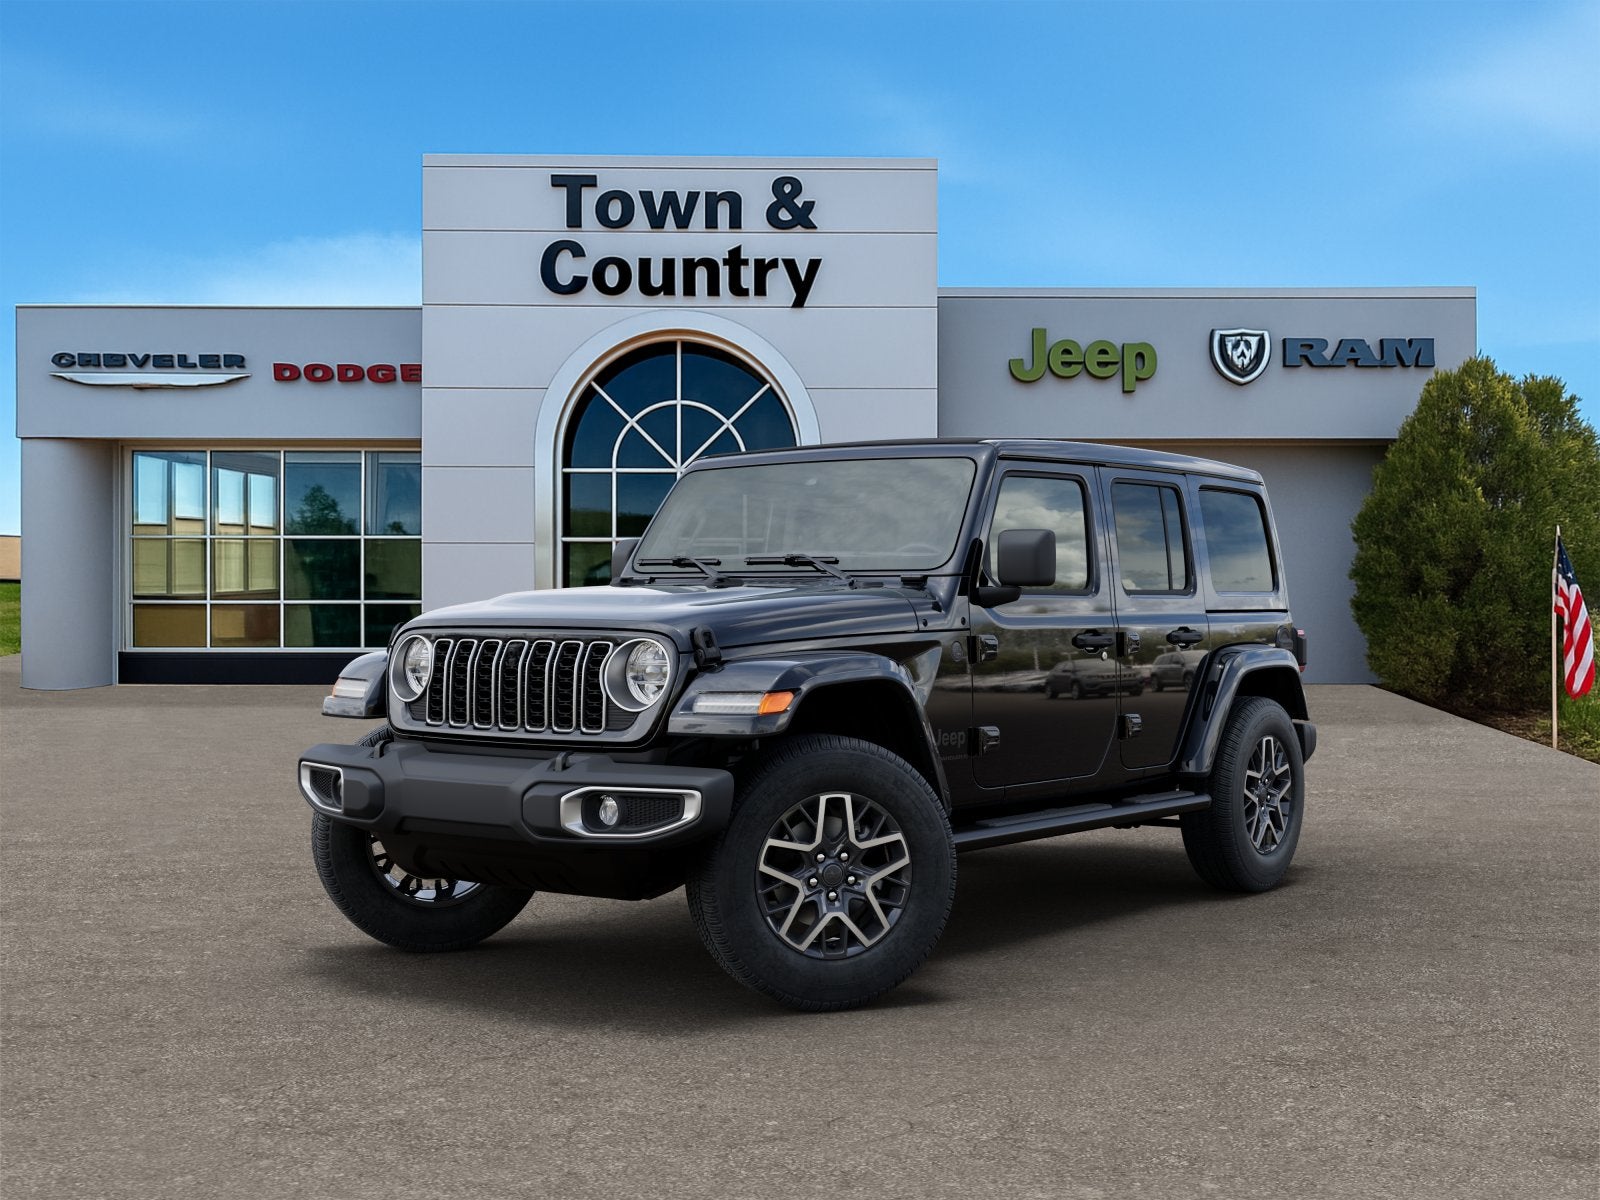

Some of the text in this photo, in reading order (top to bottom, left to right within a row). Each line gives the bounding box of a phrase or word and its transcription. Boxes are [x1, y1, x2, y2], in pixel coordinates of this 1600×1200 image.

[550, 174, 818, 230] Town &
[540, 239, 822, 308] Country
[273, 362, 422, 383] DODGE
[1009, 327, 1158, 393] Jeep
[1282, 337, 1436, 368] RAM
[935, 728, 966, 748] Jeep
